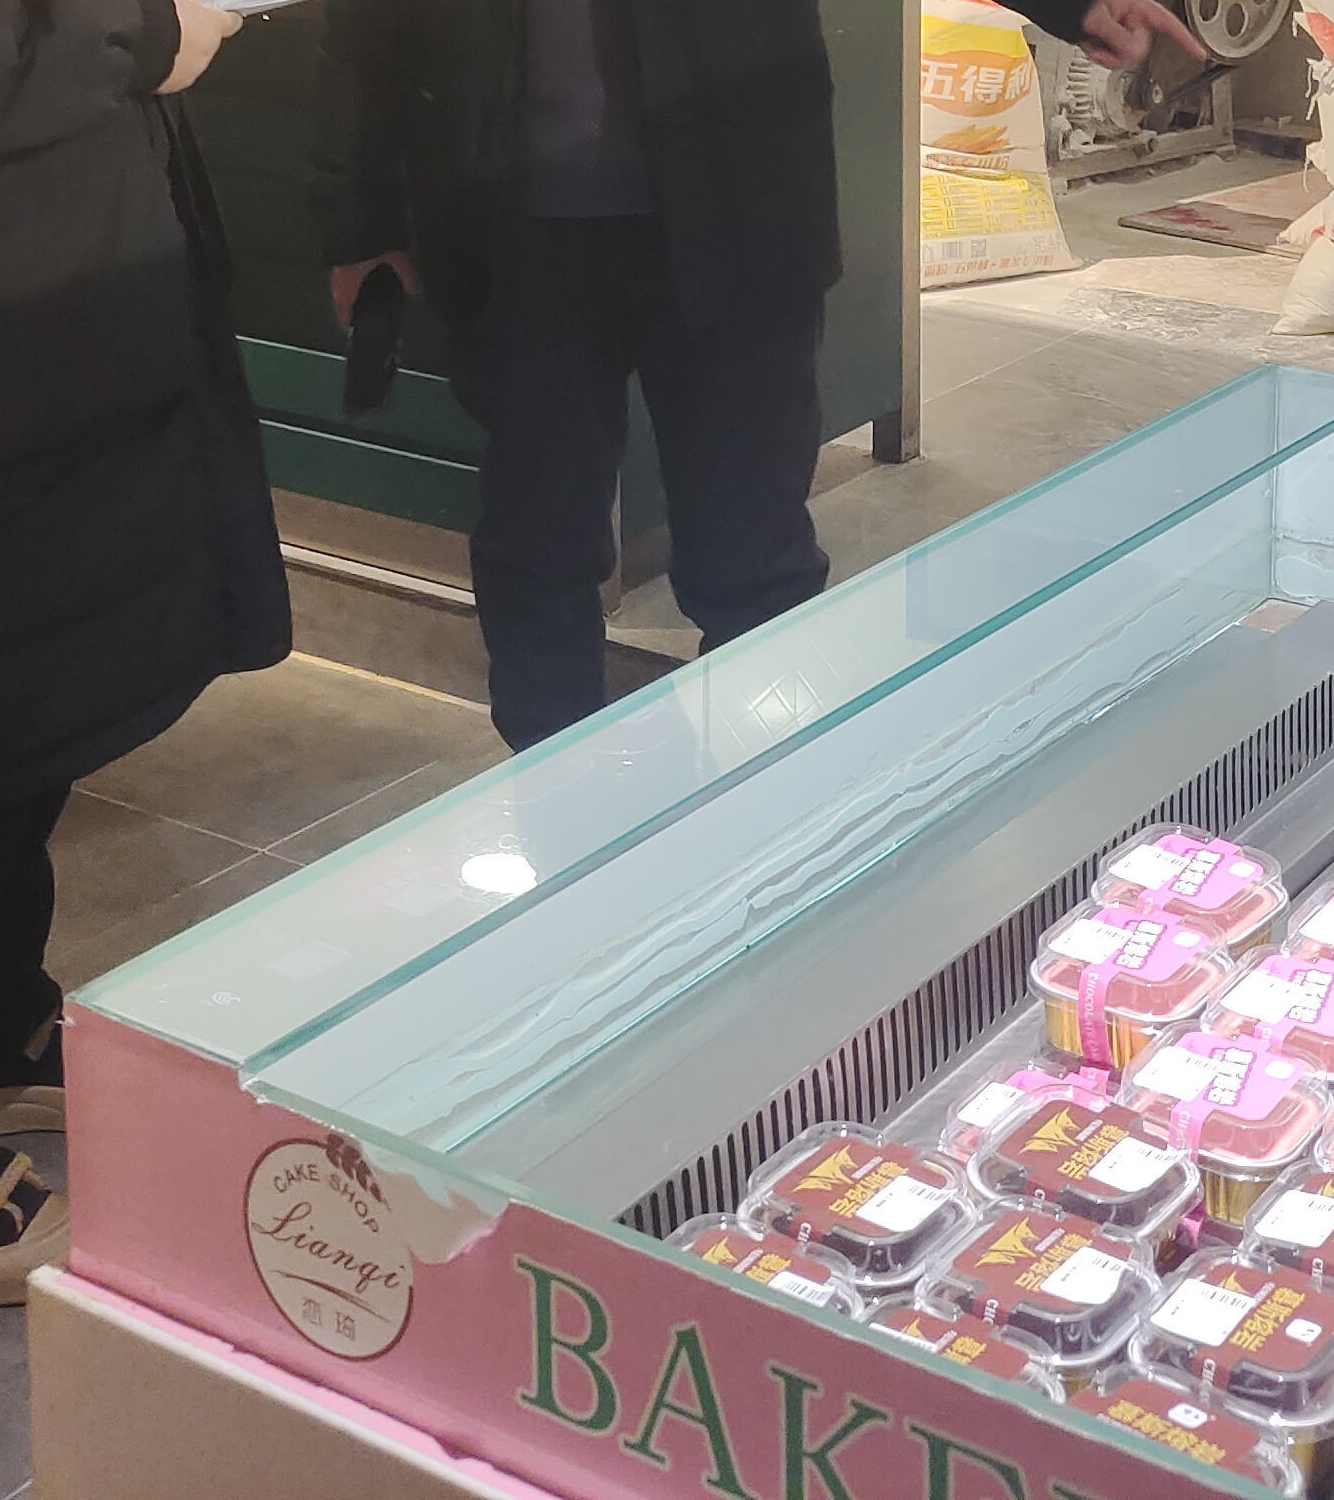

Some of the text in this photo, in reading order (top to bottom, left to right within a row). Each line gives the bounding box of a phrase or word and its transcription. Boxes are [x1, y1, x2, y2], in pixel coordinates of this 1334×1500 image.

[921, 58, 1034, 104] 五得利
[274, 1164, 380, 1233] CAKE SHOP
[251, 1201, 406, 1294] Lianqi
